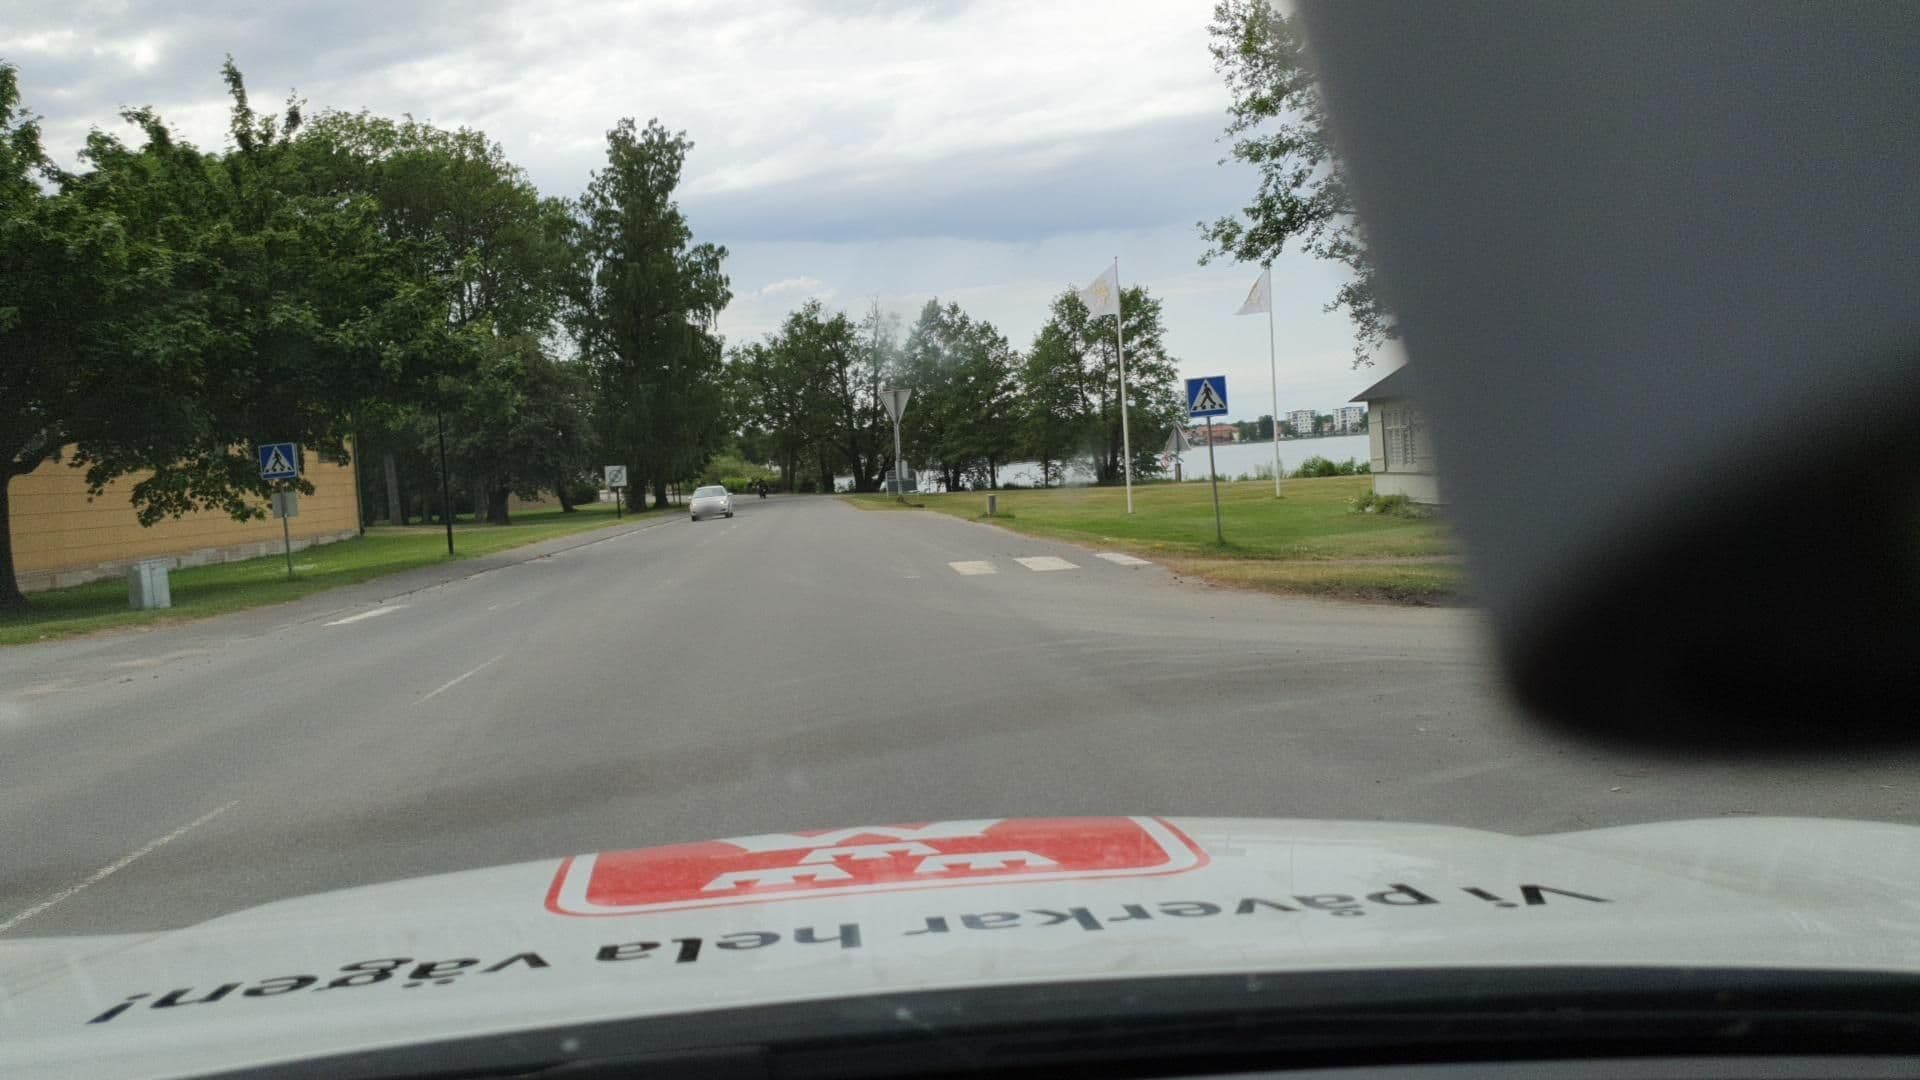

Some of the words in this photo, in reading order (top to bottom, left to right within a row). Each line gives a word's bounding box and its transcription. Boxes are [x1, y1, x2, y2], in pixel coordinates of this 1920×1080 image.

[903, 882, 1438, 935] påverkar
[1459, 883, 1611, 909] Vi
[595, 922, 862, 964] hela
[86, 951, 551, 1025] vägen!
